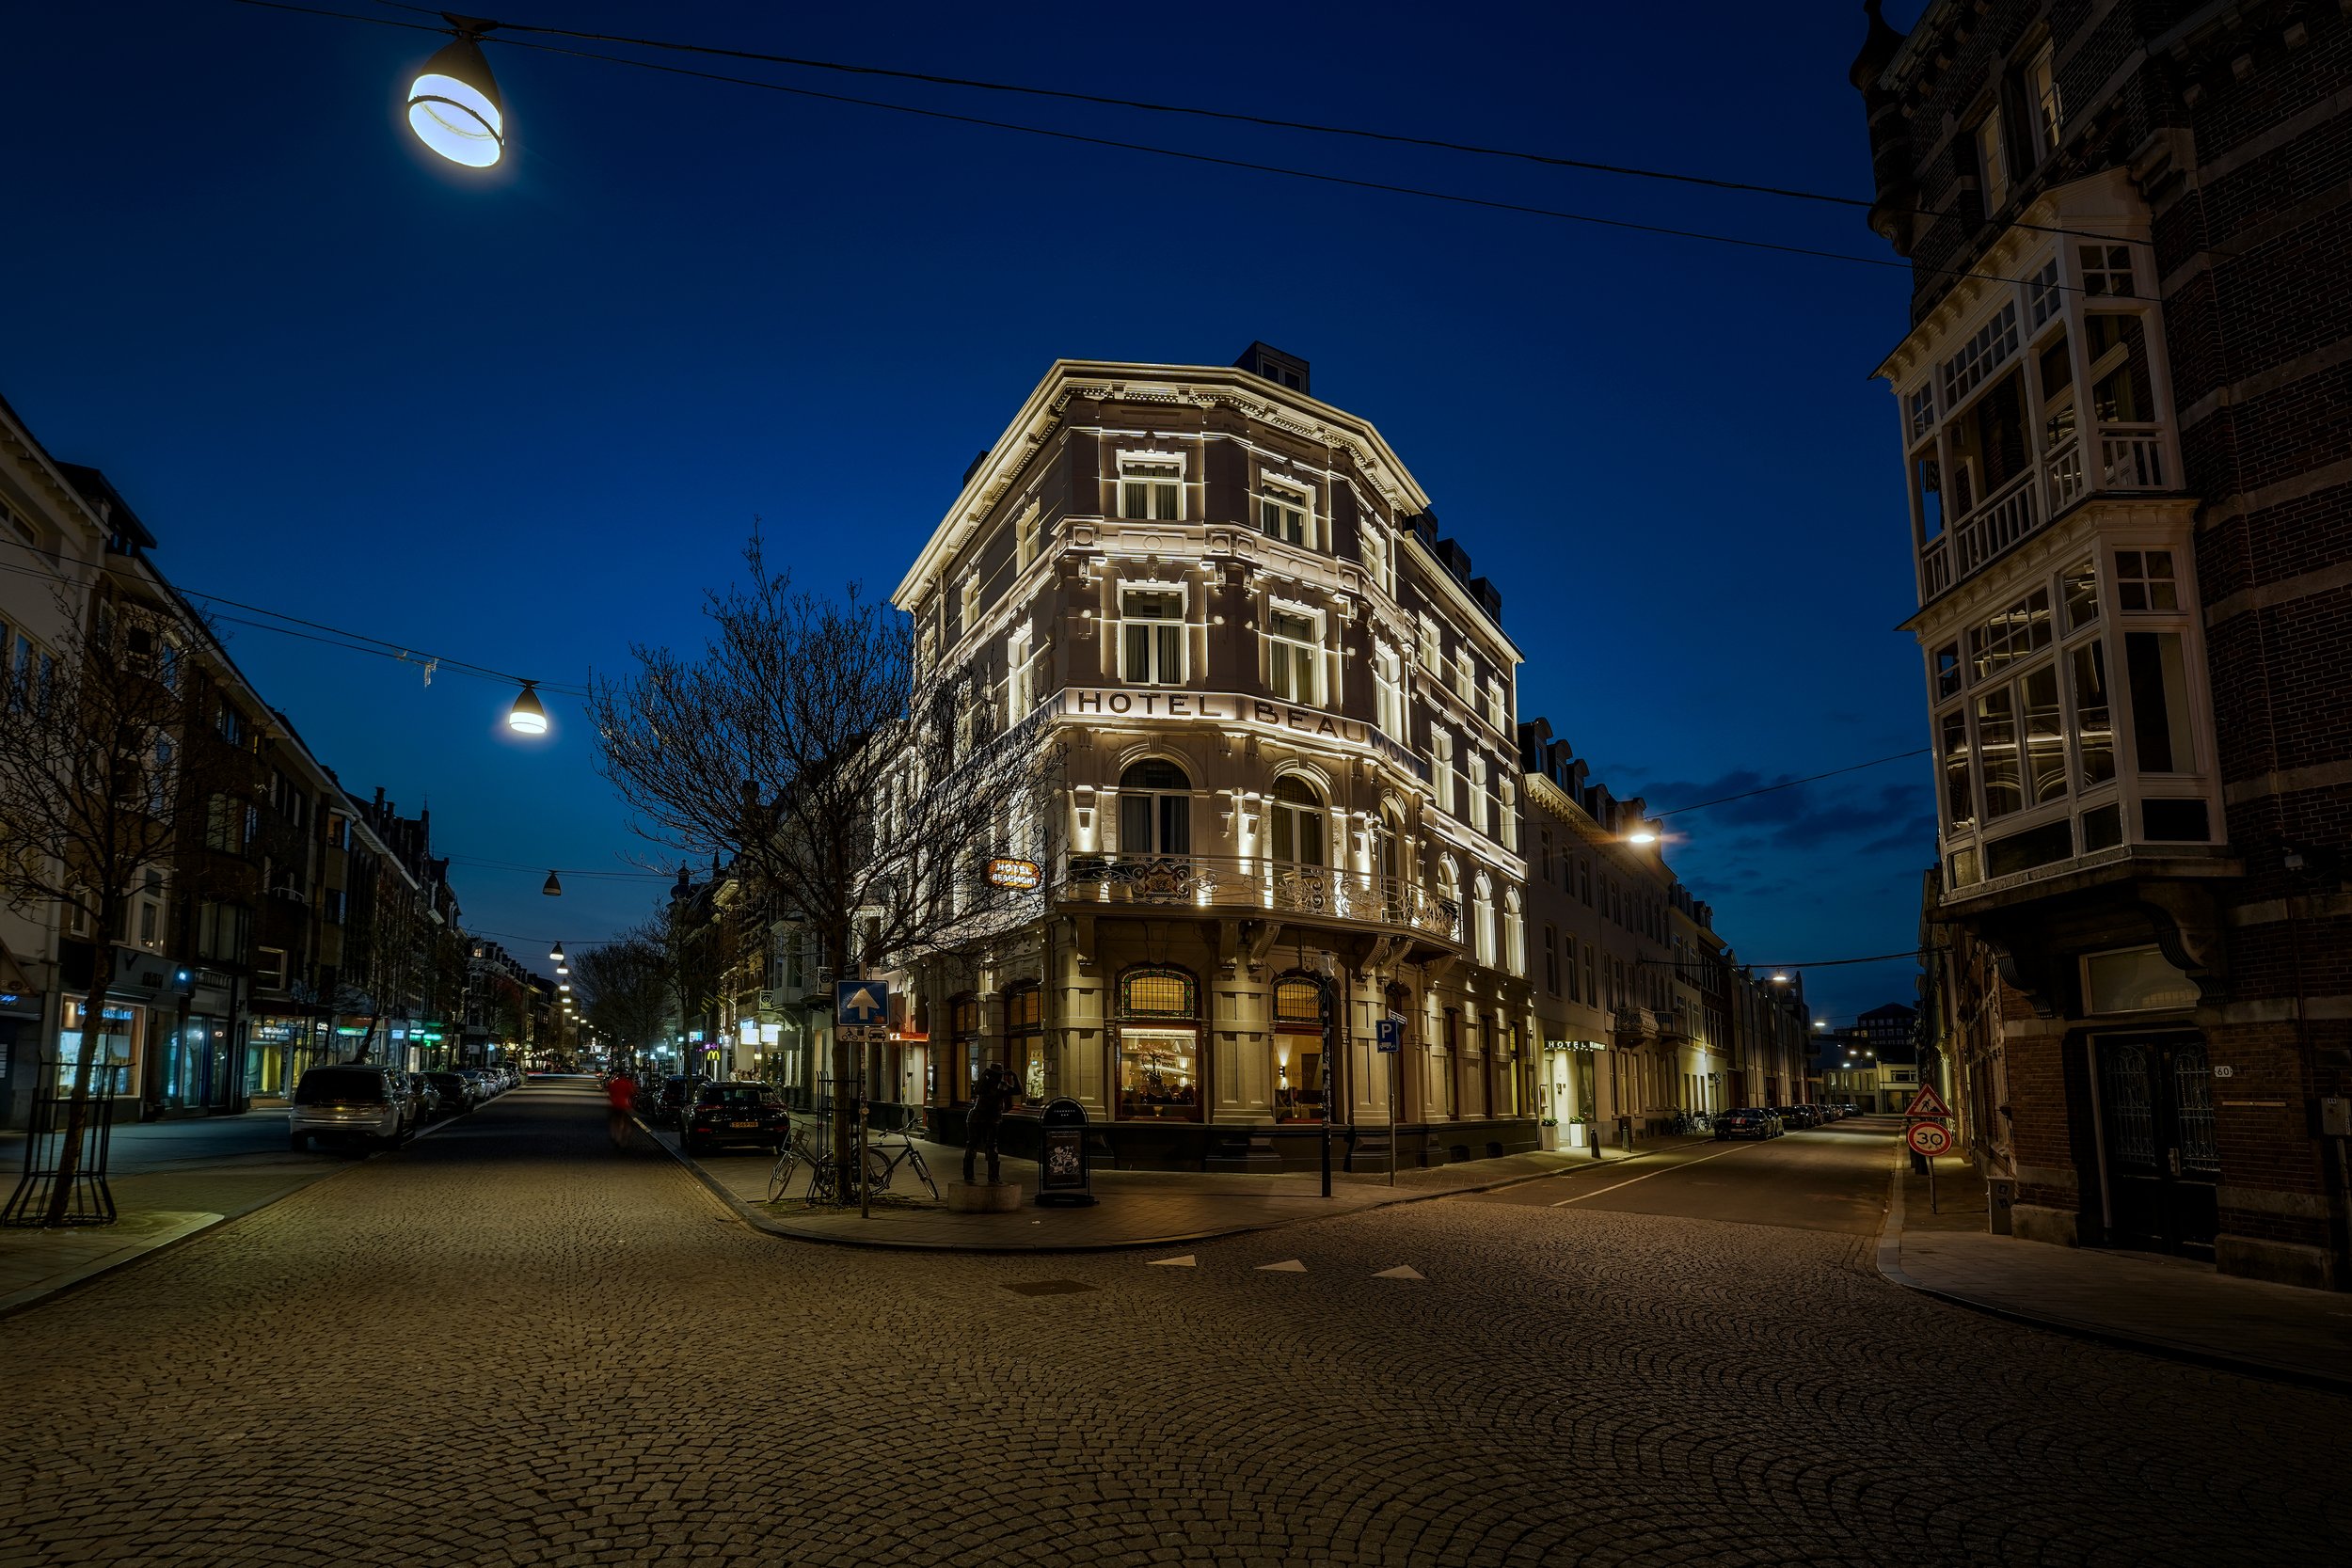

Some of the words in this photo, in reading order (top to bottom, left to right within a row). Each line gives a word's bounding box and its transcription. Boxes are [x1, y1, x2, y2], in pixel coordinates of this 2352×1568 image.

[1077, 690, 1222, 717] HOTEL
[1254, 700, 1425, 778] BEAUMONT
[996, 863, 1032, 875] HOTEL
[992, 873, 1037, 885] BEAUMONT
[1381, 1023, 1393, 1038] P
[1548, 1040, 1586, 1049] HOTEL
[2217, 1067, 2230, 1076] 60
[1916, 1132, 1944, 1146] 30
